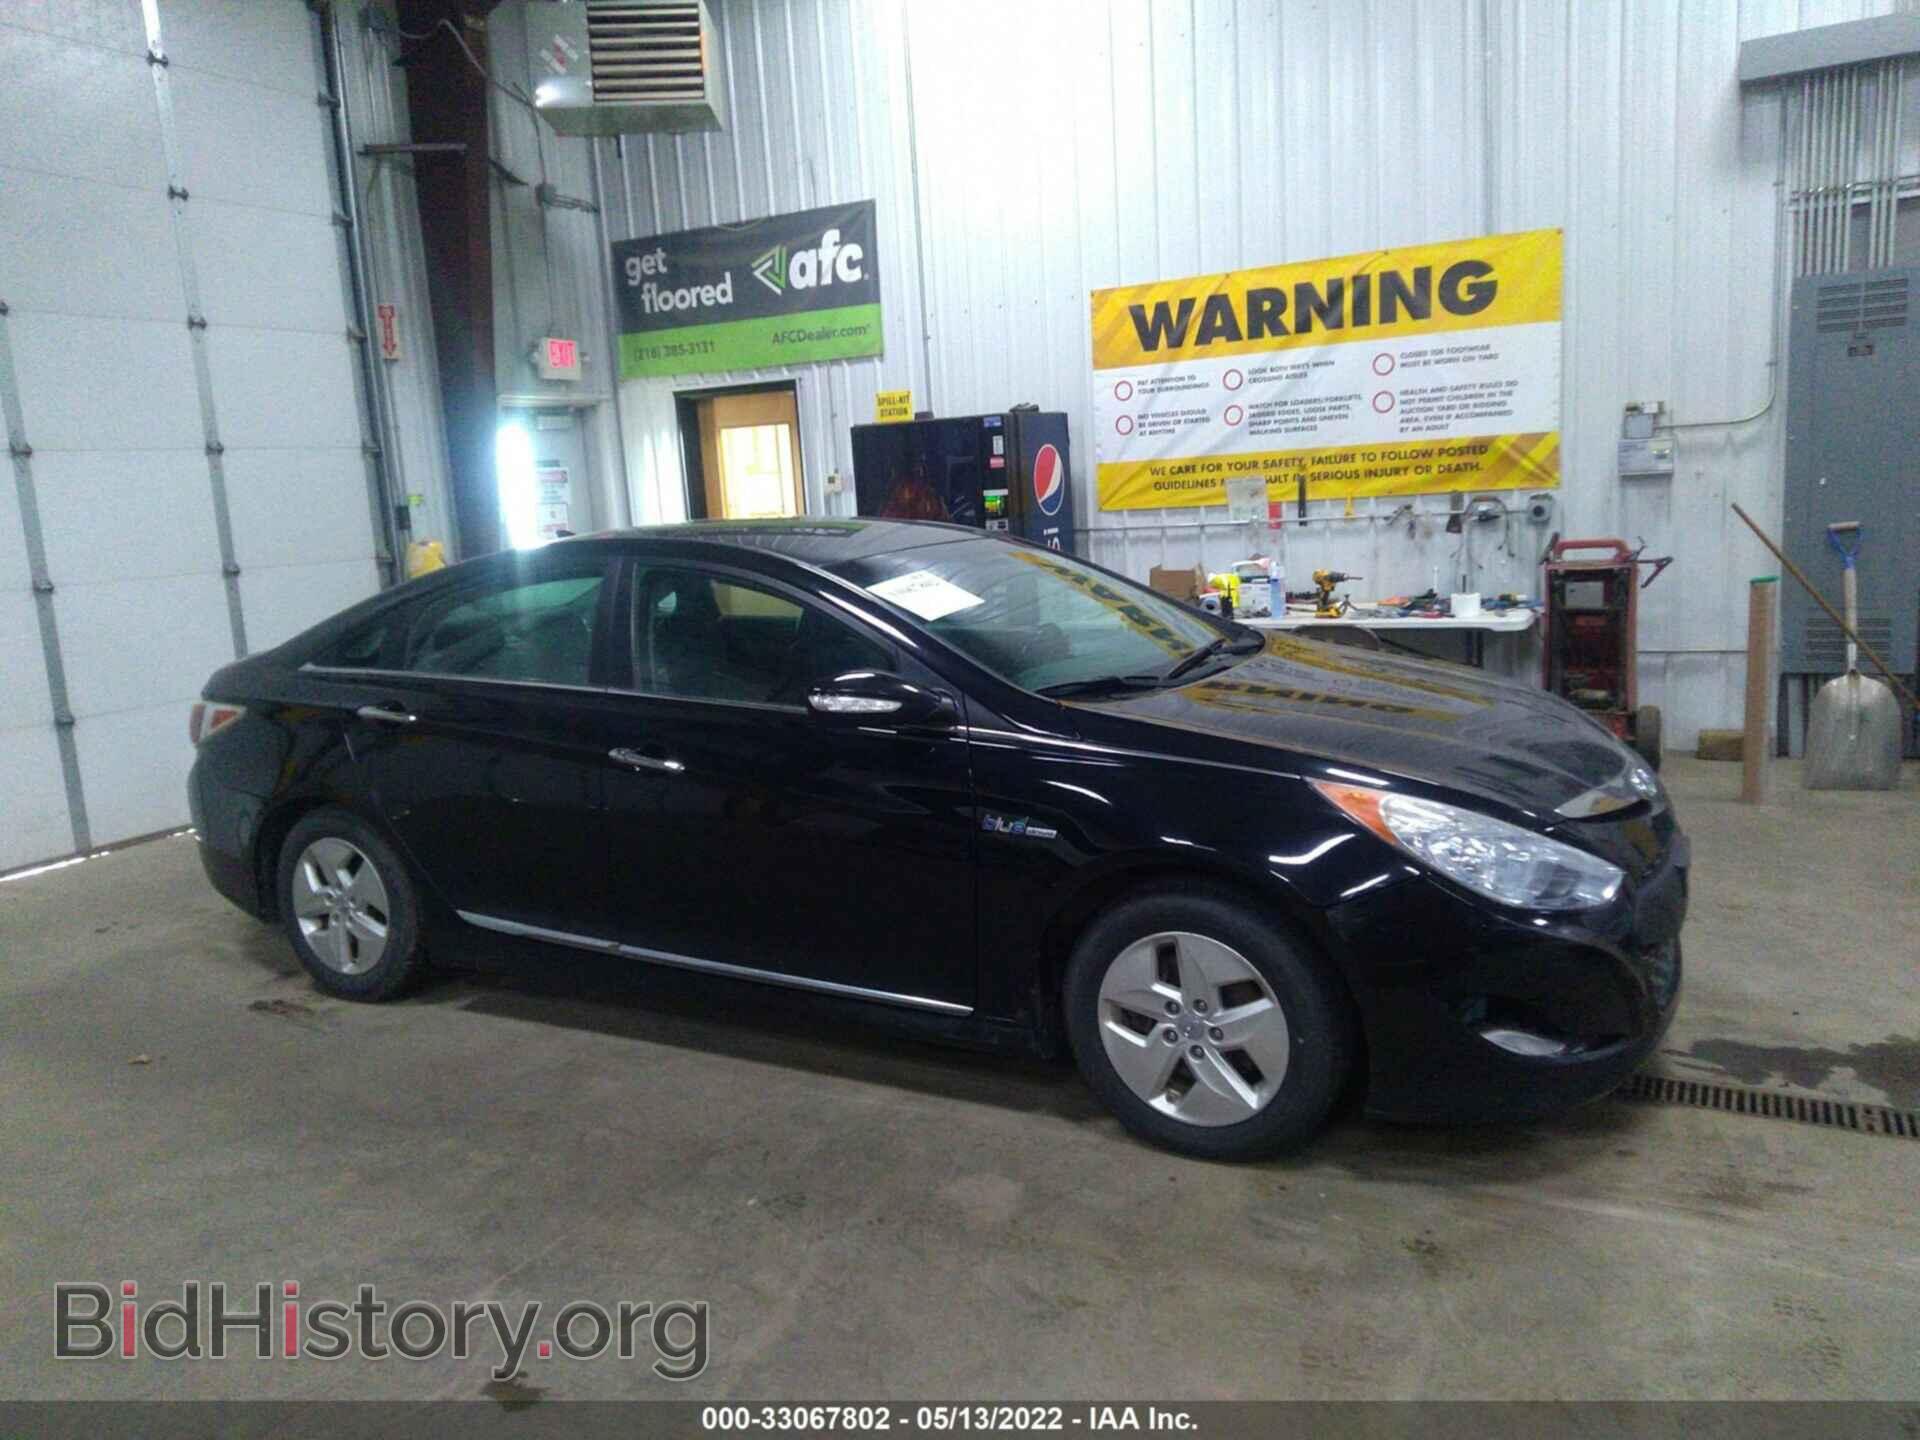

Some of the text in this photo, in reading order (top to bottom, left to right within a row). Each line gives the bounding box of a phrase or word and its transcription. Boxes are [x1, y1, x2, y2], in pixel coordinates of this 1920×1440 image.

[624, 248, 668, 287] get
[641, 271, 734, 314] floored
[1128, 259, 1499, 352] WARNING
[548, 339, 577, 368] EXIT
[1150, 466, 1166, 476] WE
[1168, 464, 1197, 476] CARE
[1200, 463, 1223, 473] FOR
[1226, 460, 1259, 471] YOUR
[1311, 453, 1357, 466] FAILURE
[1361, 451, 1377, 462] TO
[1381, 447, 1434, 461] FOLLOW
[1438, 444, 1489, 458] POSTED
[1153, 478, 1217, 491] GUIDELINES
[1309, 468, 1360, 482] SERIOUS
[1364, 465, 1409, 479] INJURY
[1413, 463, 1432, 475] OR
[1437, 461, 1483, 475] DEATH.
